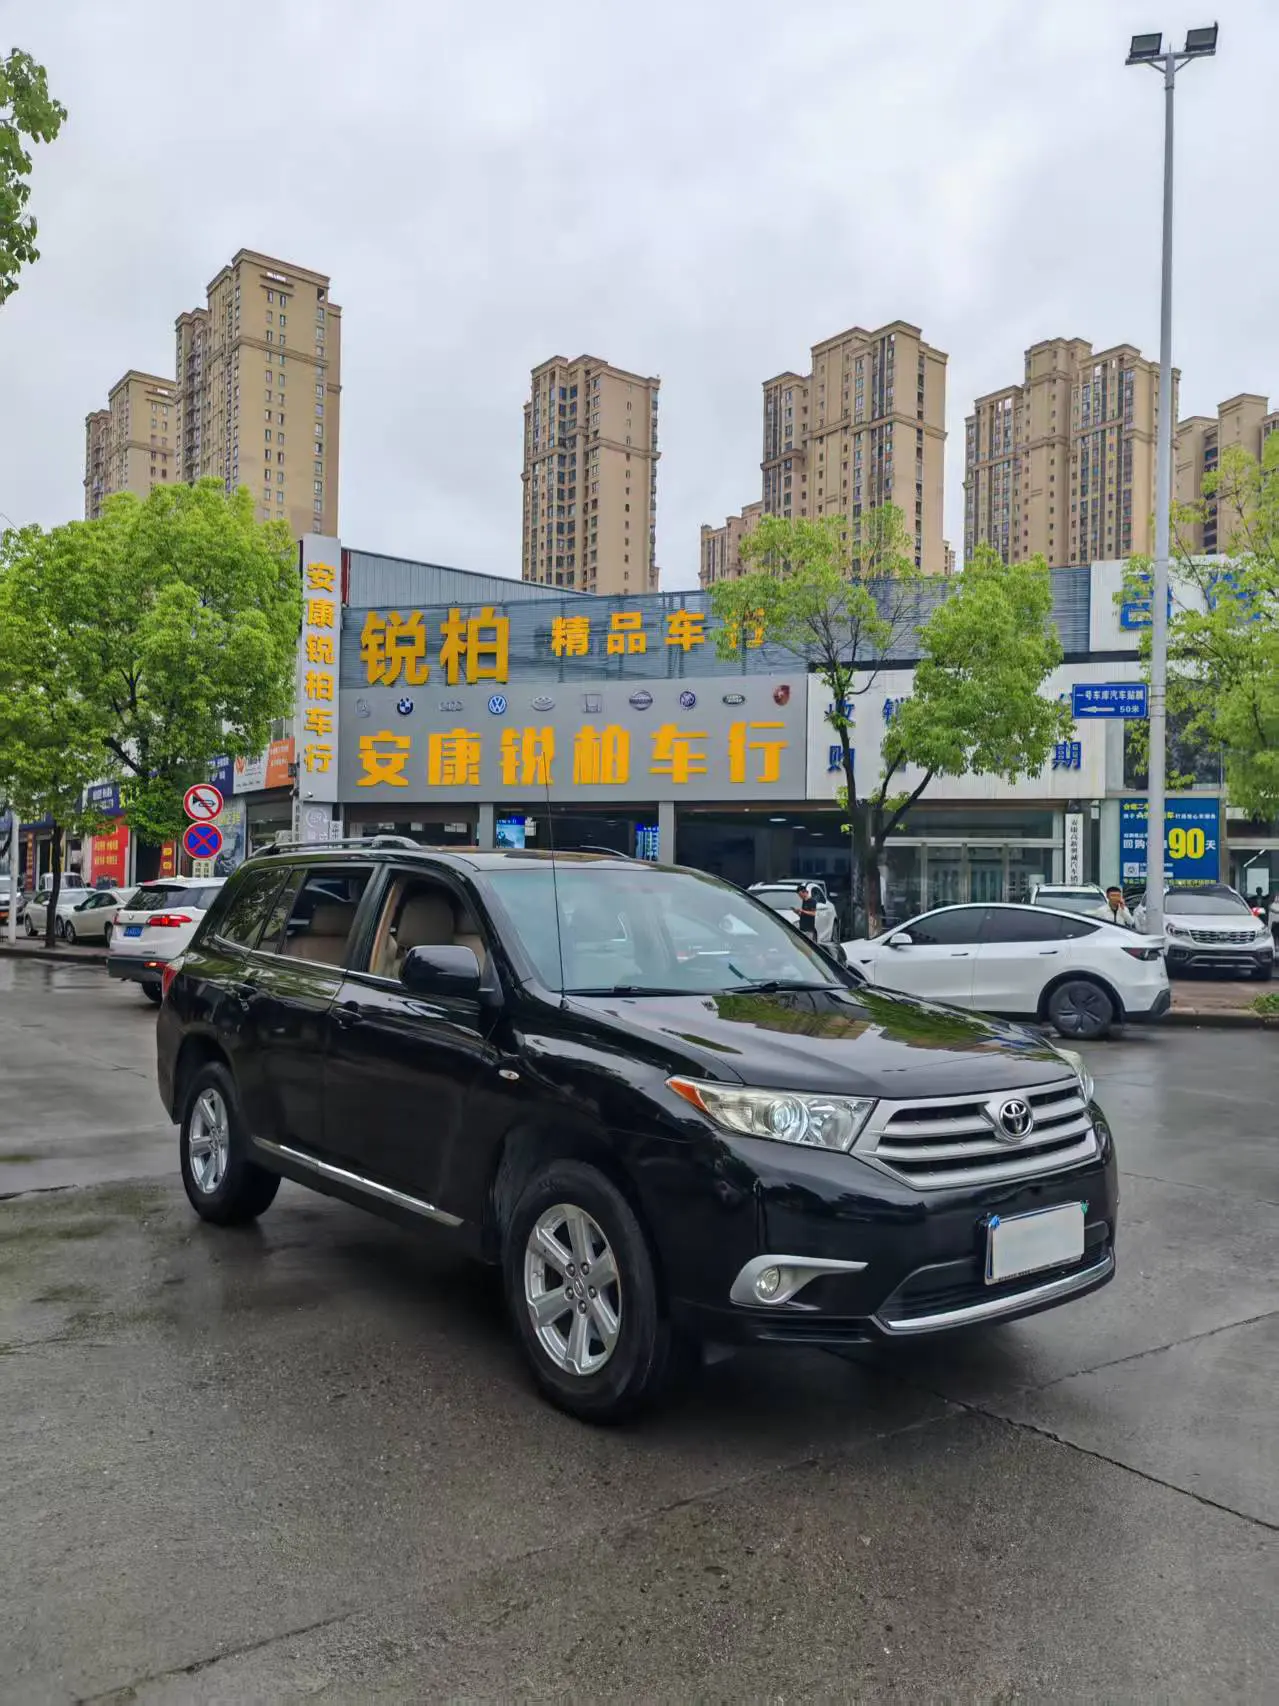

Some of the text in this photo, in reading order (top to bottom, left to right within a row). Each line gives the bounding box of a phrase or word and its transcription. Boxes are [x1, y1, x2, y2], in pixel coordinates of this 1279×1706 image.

[304, 562, 336, 773] 安康锐柏车行
[360, 606, 510, 686] 锐柏
[356, 721, 789, 786] 安康锐柏车行
